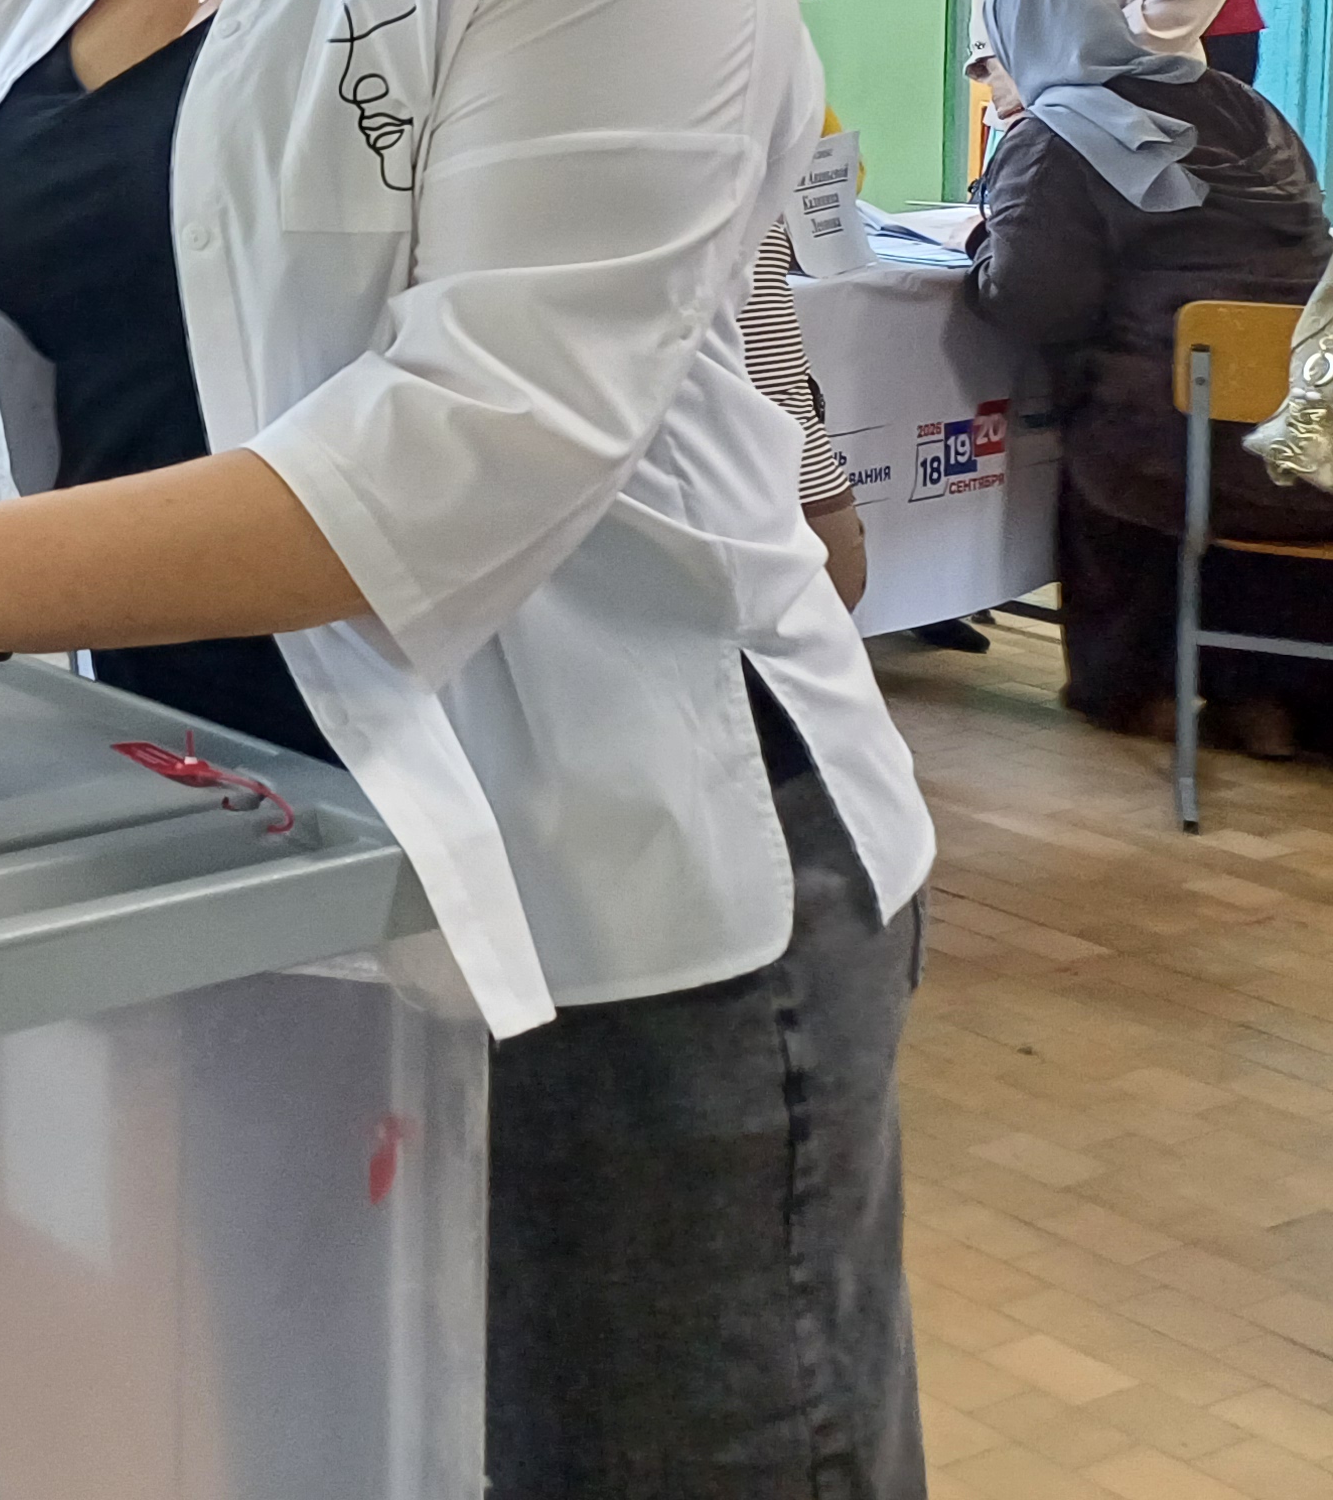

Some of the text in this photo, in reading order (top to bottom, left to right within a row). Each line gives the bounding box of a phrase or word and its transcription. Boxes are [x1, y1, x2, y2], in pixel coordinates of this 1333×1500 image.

[920, 412, 1008, 487] 18 19 20
[849, 465, 891, 488] ВАНИЯ
